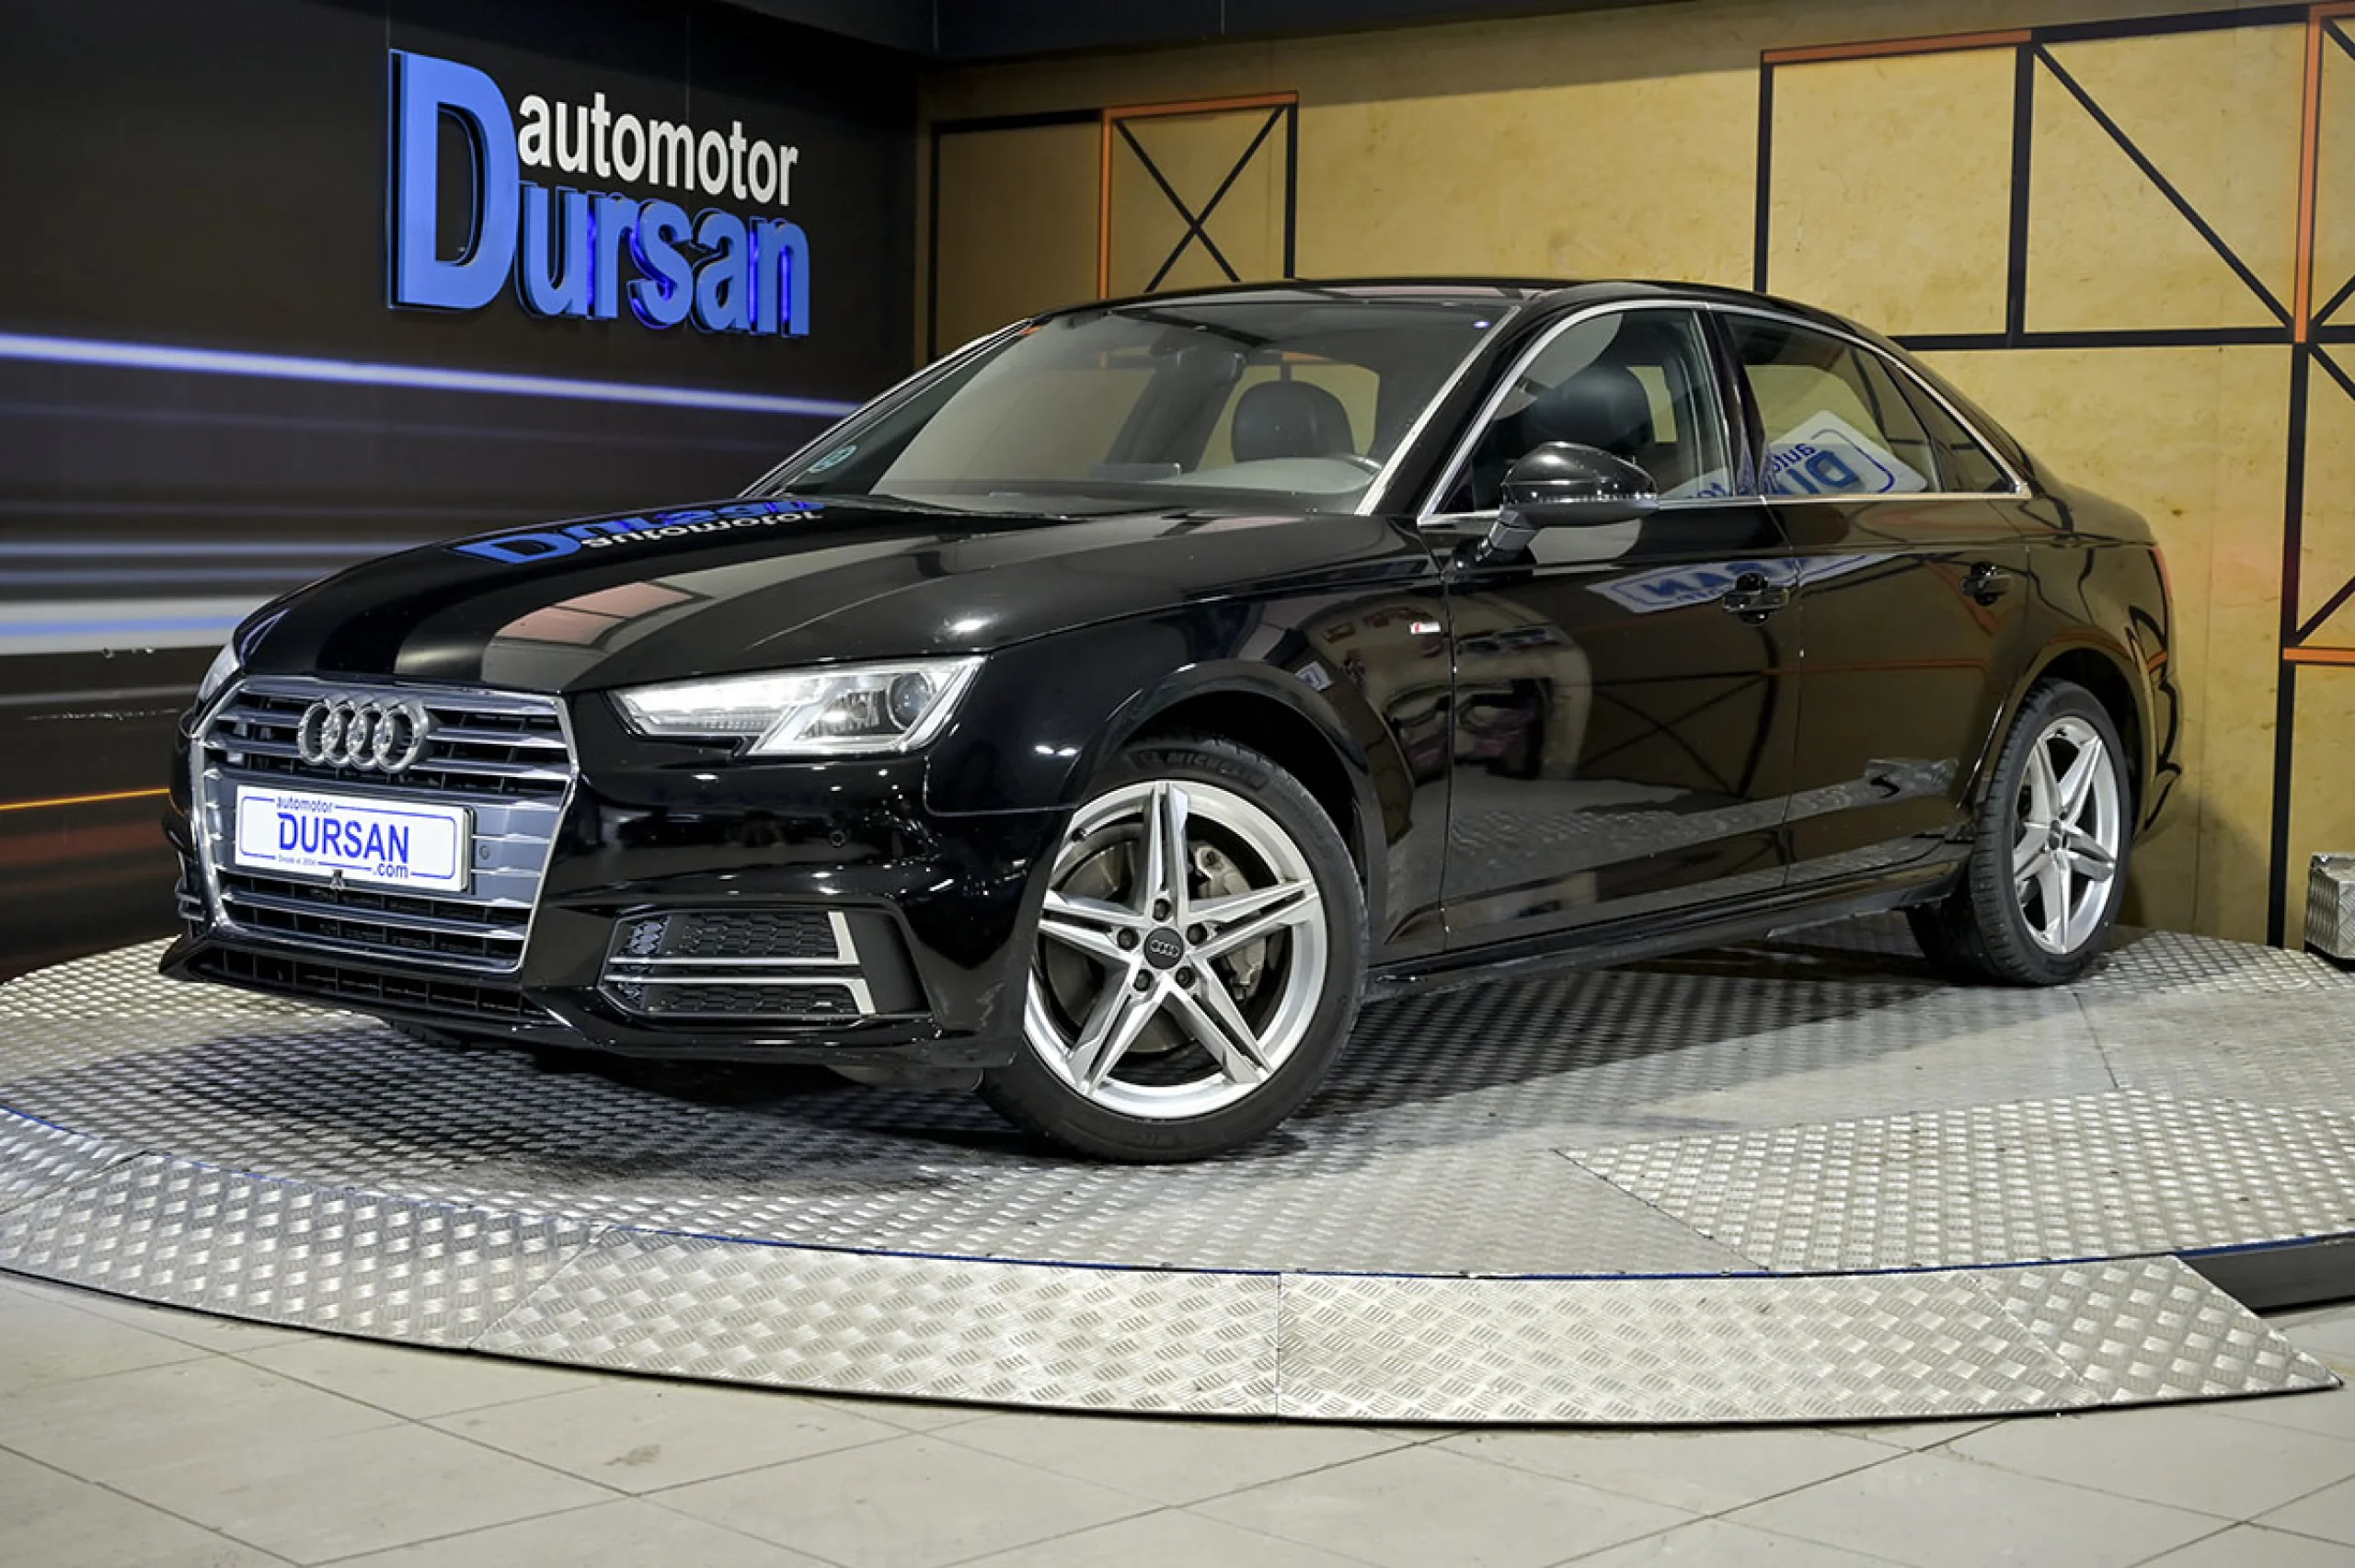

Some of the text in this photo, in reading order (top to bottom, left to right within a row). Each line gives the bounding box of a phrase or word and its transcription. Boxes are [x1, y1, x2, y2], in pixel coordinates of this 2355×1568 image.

[517, 92, 798, 206] automotor
[388, 49, 810, 338] Dursan
[278, 796, 333, 812] automotor
[278, 813, 409, 863] DURSAN
[373, 863, 409, 878] .com
